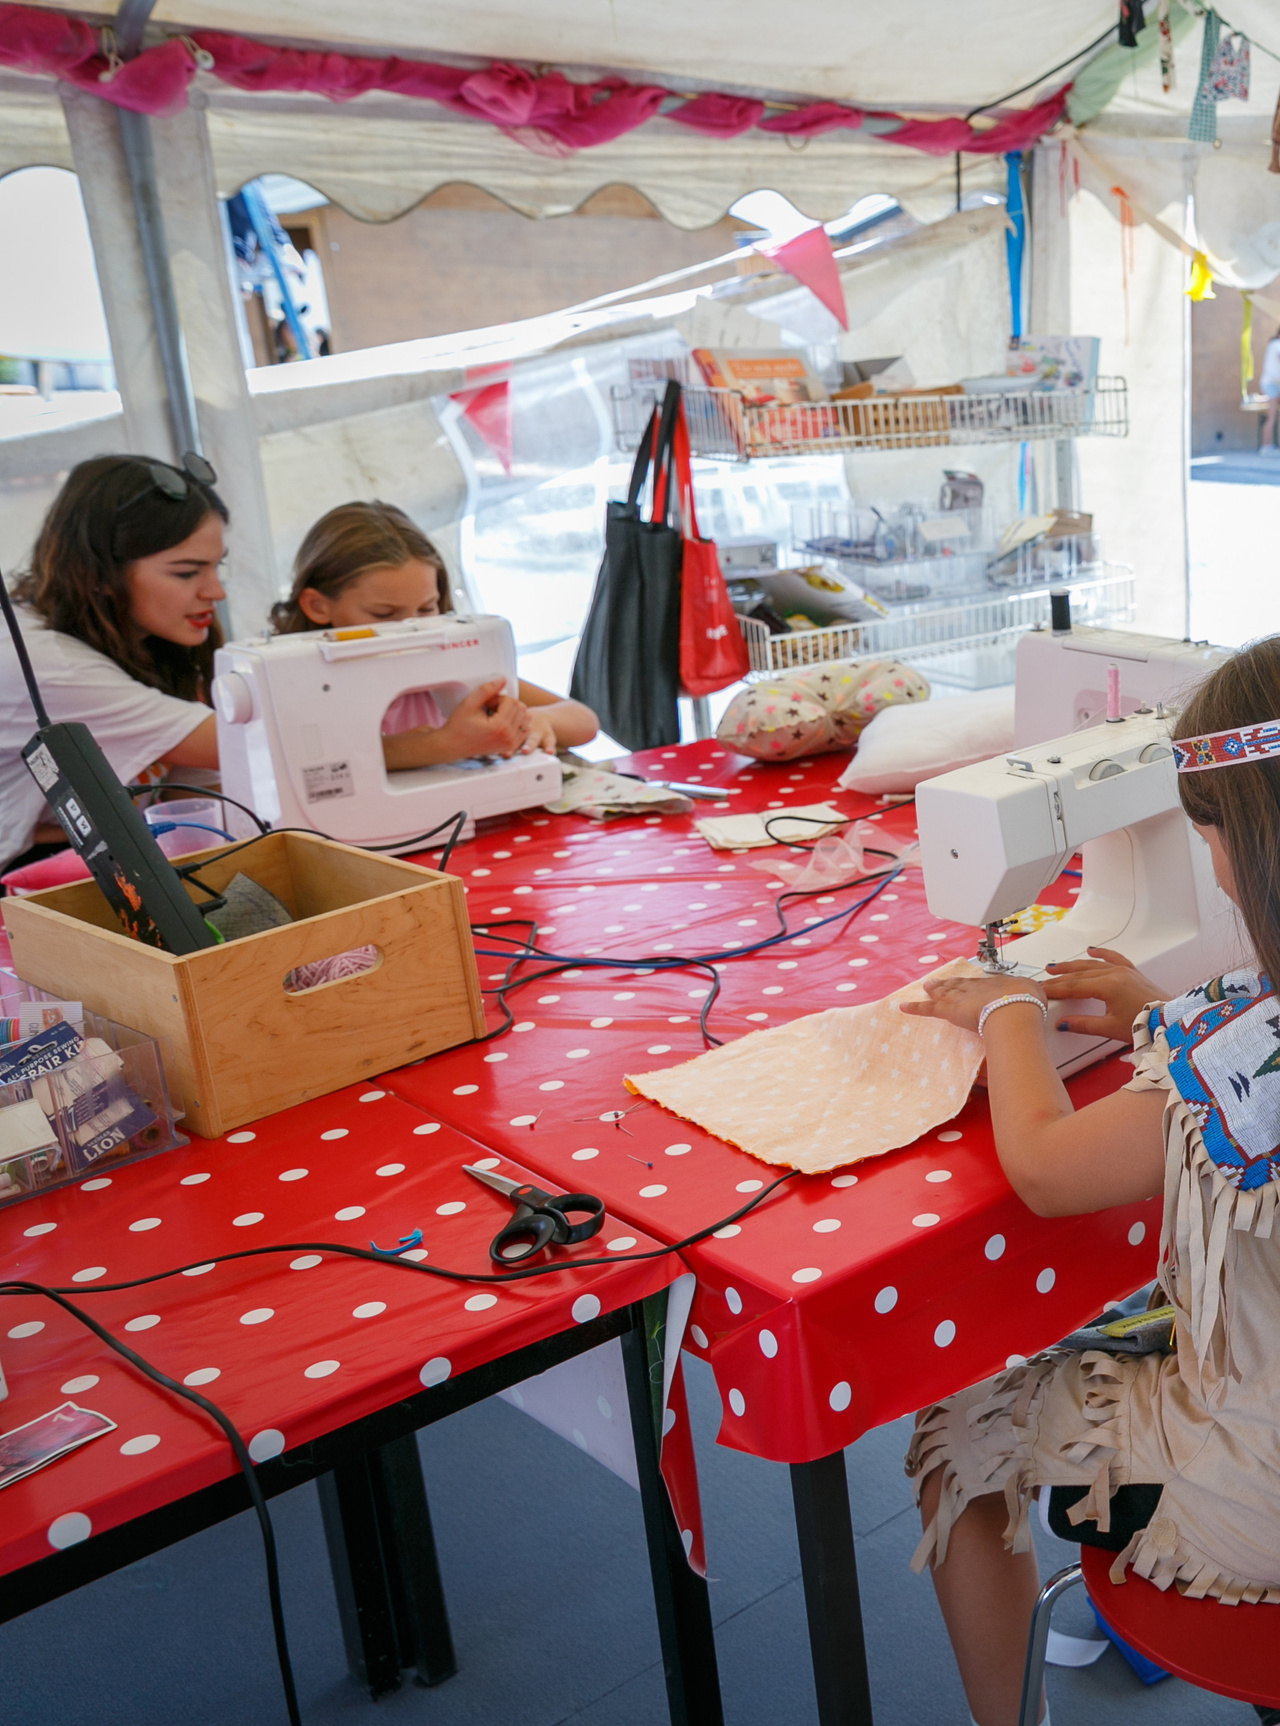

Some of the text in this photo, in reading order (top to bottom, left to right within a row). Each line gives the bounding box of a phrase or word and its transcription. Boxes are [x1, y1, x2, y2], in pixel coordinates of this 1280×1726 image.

[7, 1071, 20, 1083] ALL
[21, 1052, 53, 1074] PURPOSE
[53, 1036, 80, 1054] SEWING
[83, 1126, 126, 1162] LION
